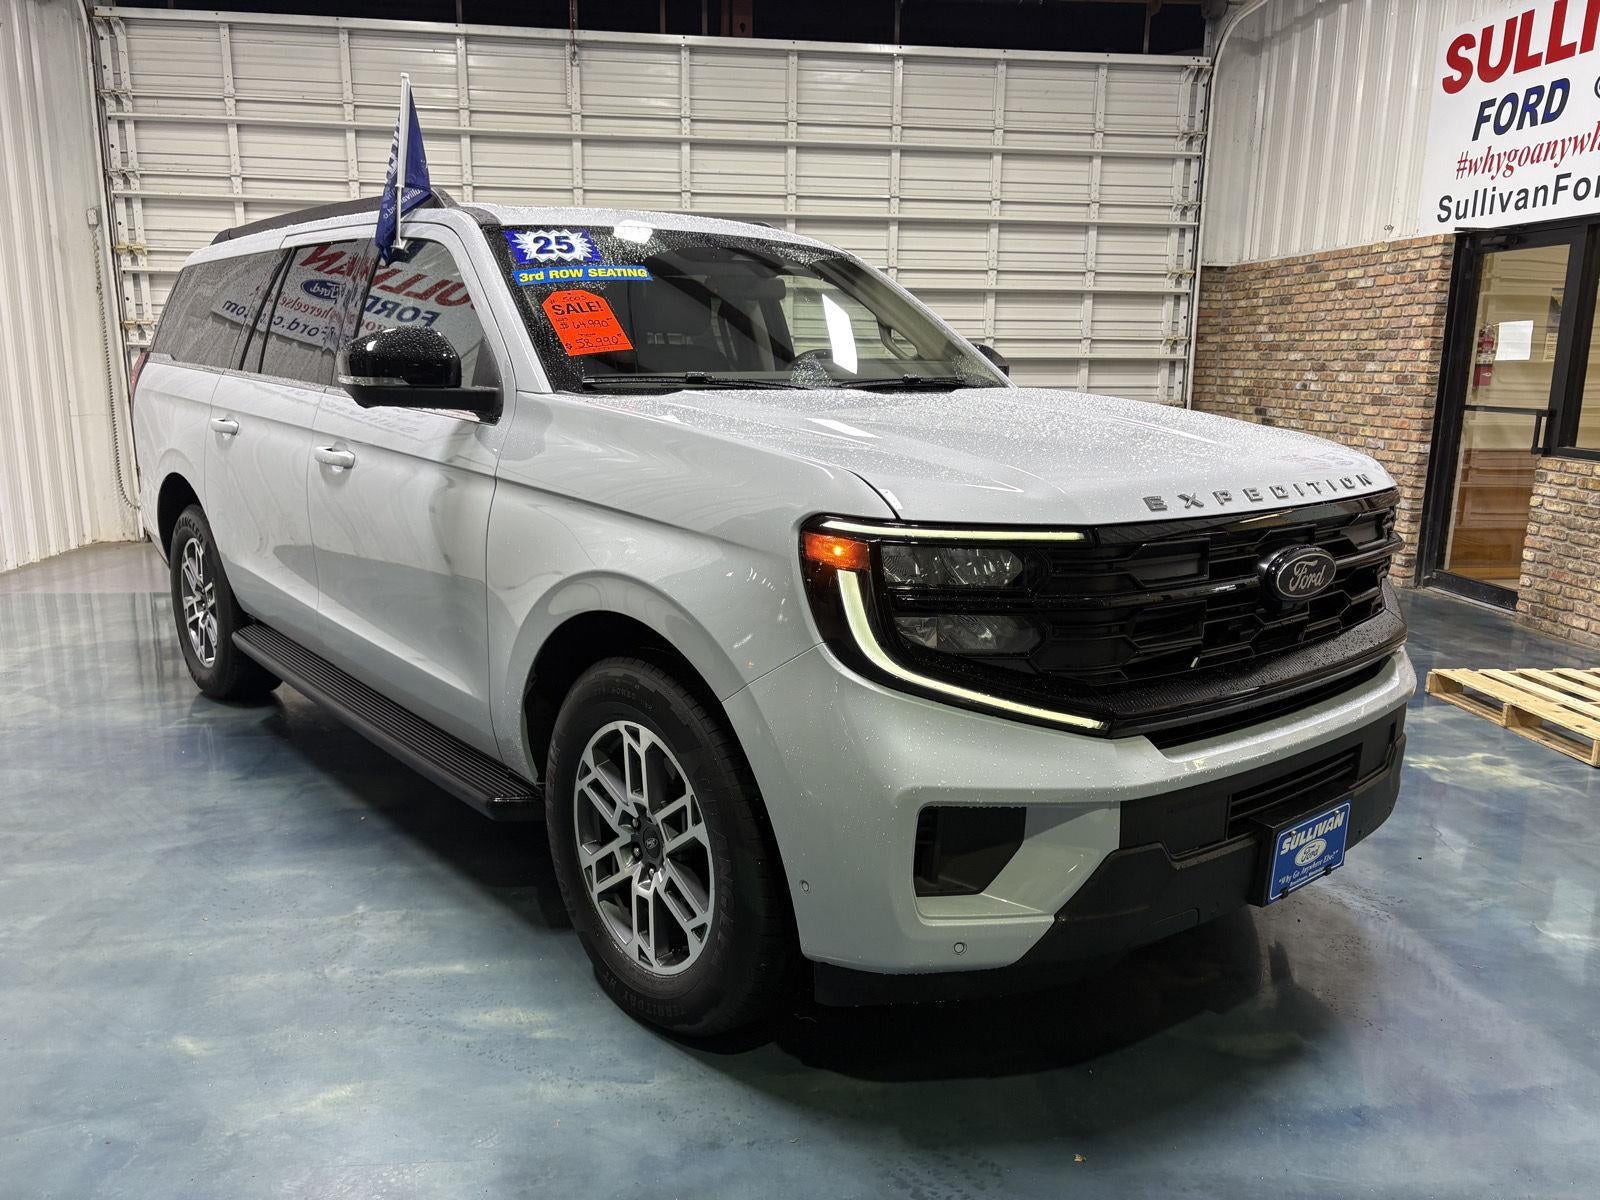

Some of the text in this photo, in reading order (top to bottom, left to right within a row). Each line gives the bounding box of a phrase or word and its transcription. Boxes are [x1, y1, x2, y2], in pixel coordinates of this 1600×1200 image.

[1472, 77, 1571, 141] FORD
[533, 236, 576, 254] 25
[519, 268, 648, 282] 3rd ROW SEATING
[552, 300, 604, 316] SALE!
[1143, 473, 1373, 511] EXPEDITION
[1289, 560, 1326, 591] Ford
[1280, 811, 1345, 856] SULLIVAN
